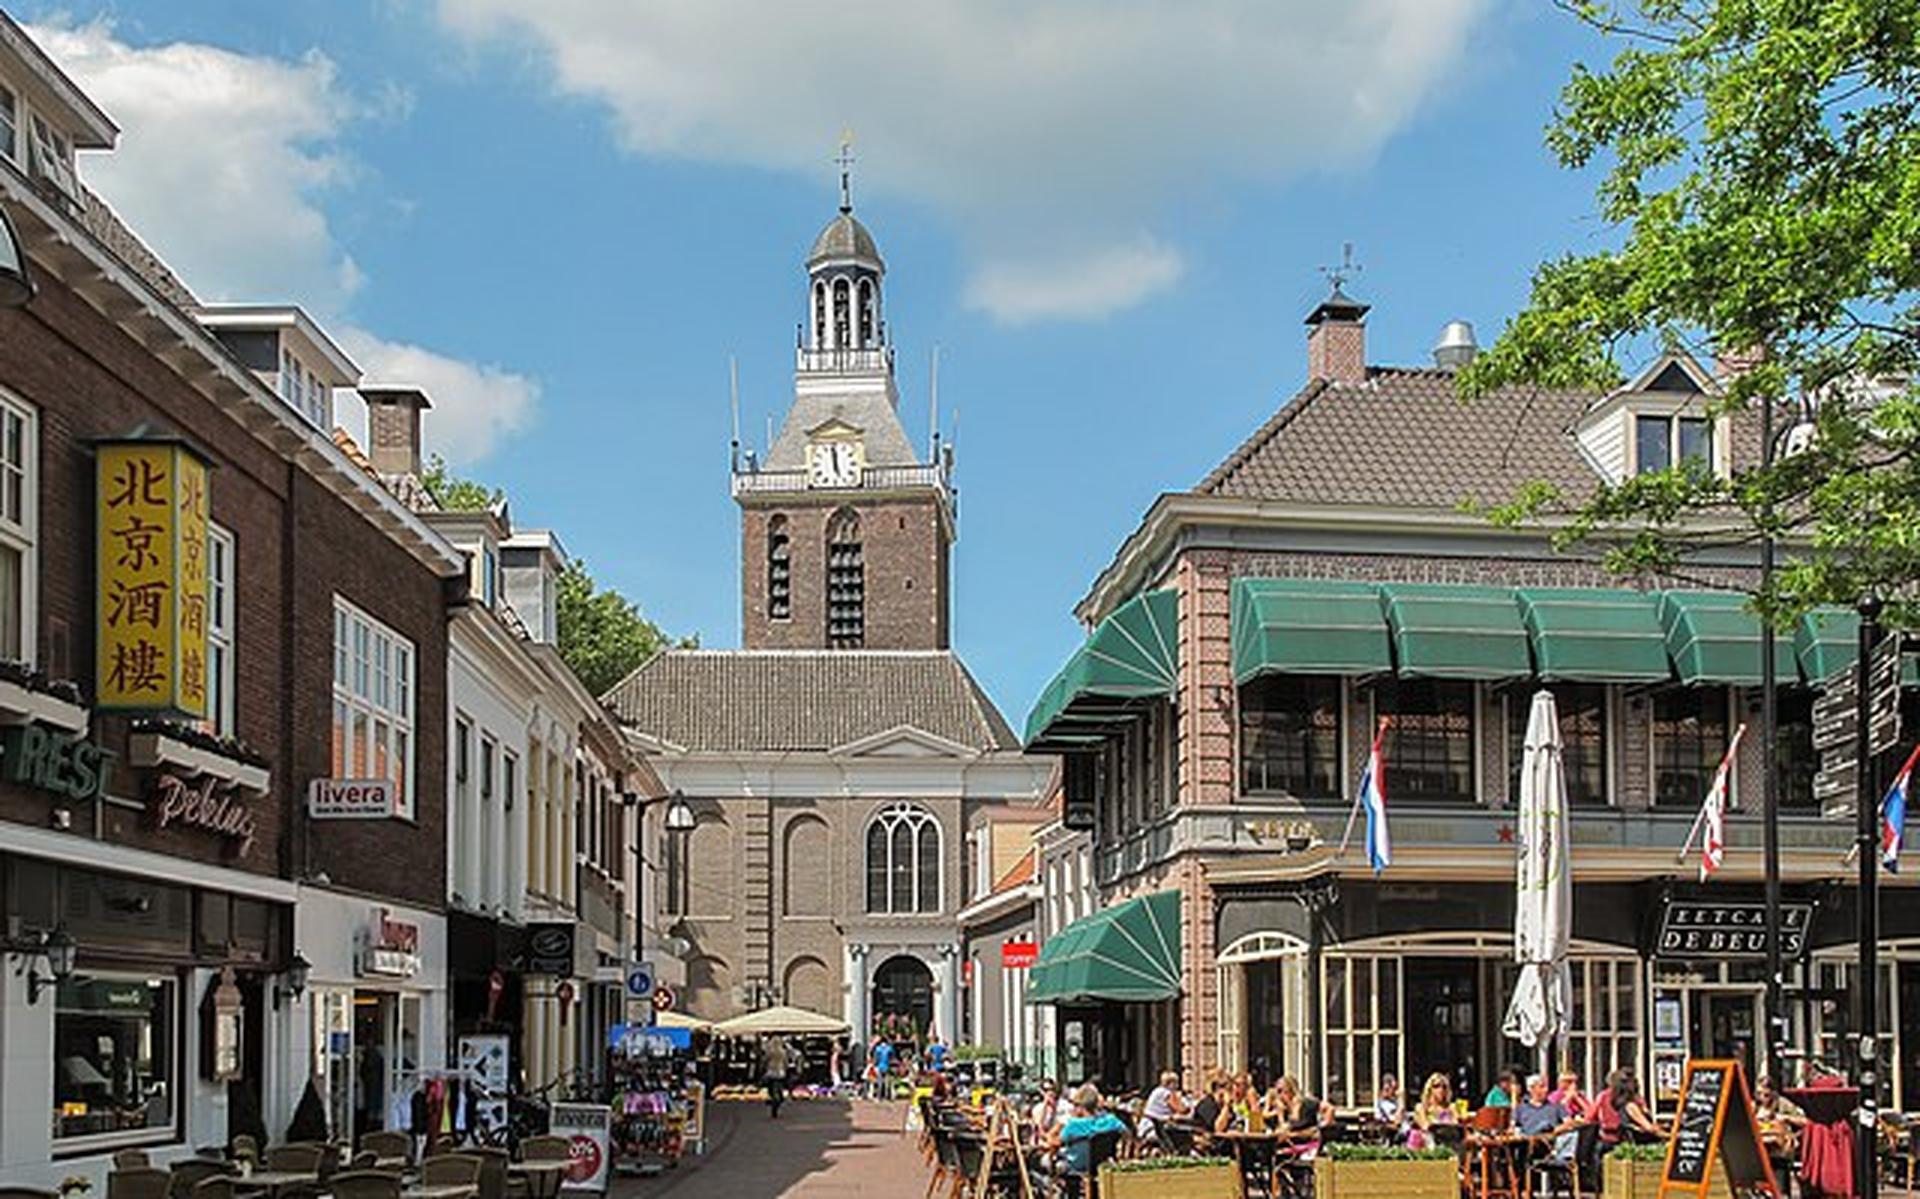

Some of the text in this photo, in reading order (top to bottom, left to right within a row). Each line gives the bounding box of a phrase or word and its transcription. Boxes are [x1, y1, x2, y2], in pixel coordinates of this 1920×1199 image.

[106, 459, 169, 692] 北京酒樓
[181, 473, 205, 701] 北京酒樓
[316, 780, 386, 804] livera
[1676, 909, 1798, 926] EETCAÉ
[1664, 931, 1700, 949] DE
